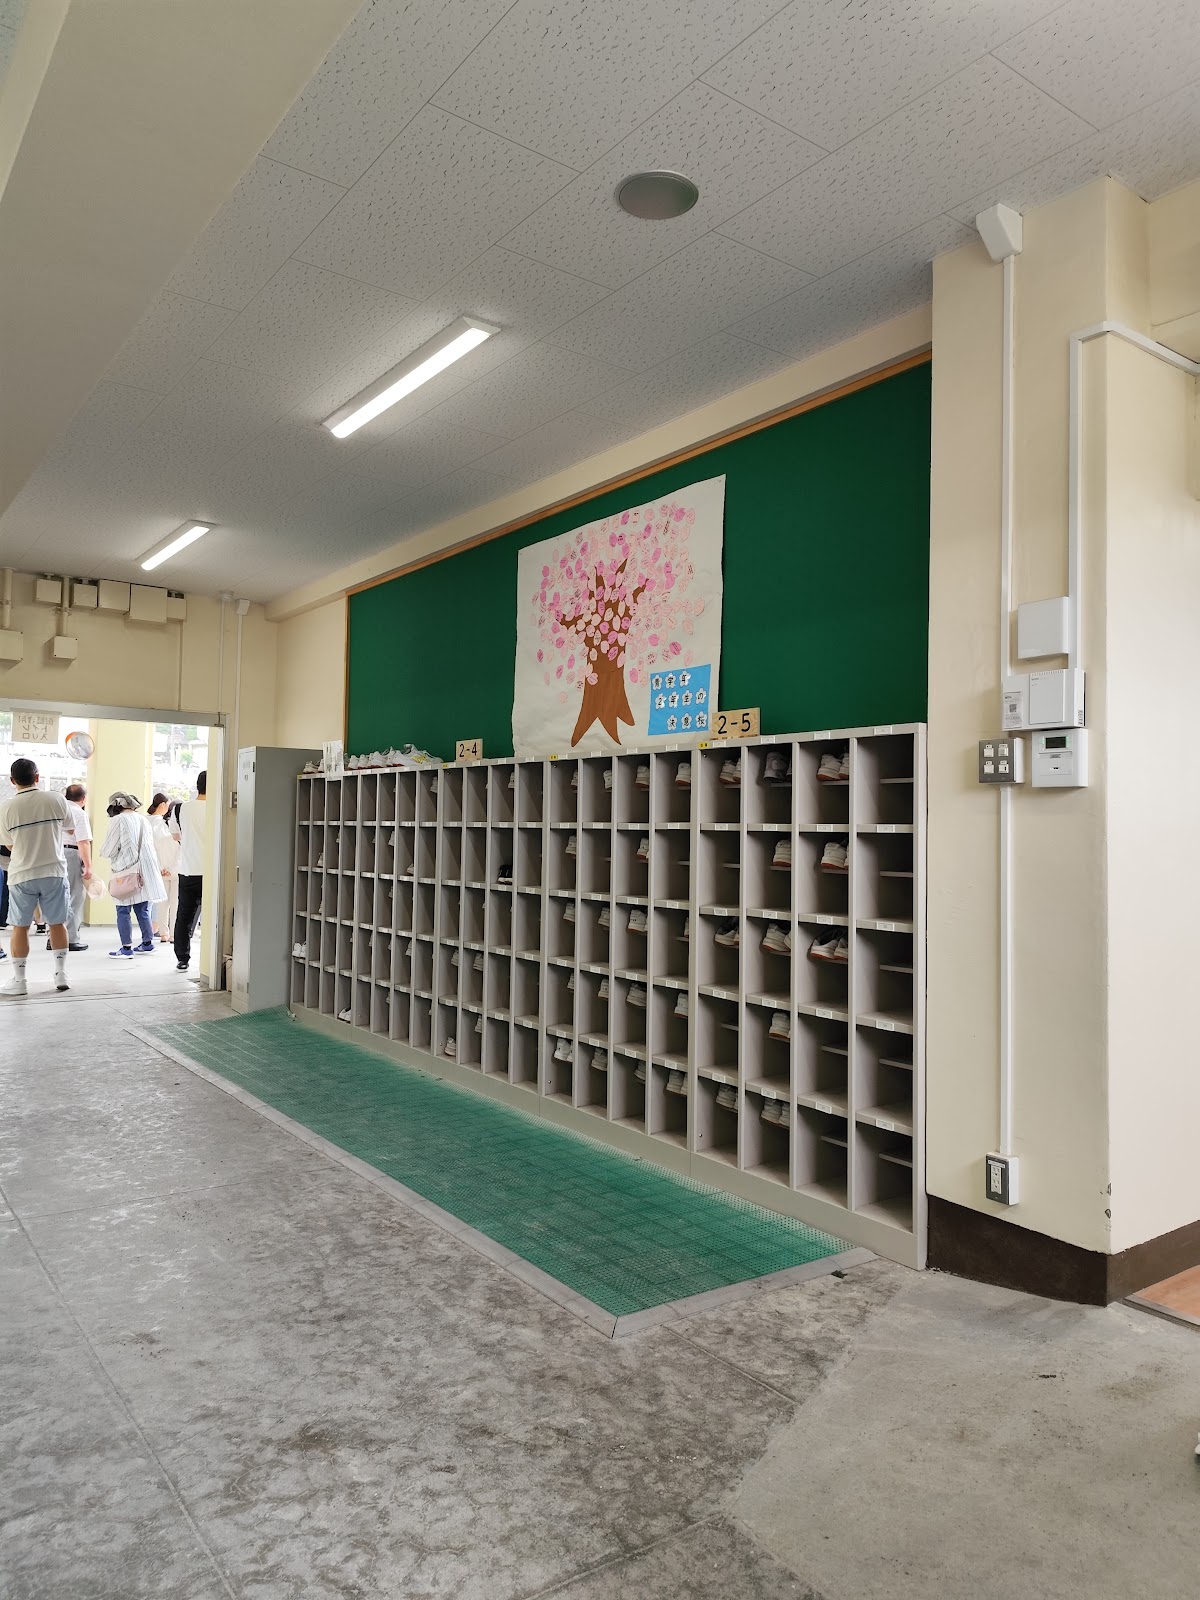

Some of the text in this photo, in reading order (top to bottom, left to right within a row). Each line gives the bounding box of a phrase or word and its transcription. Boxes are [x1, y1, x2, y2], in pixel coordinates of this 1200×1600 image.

[657, 692, 704, 706] 2年生の
[718, 713, 751, 735] 2-5
[458, 741, 478, 758] 2-4
